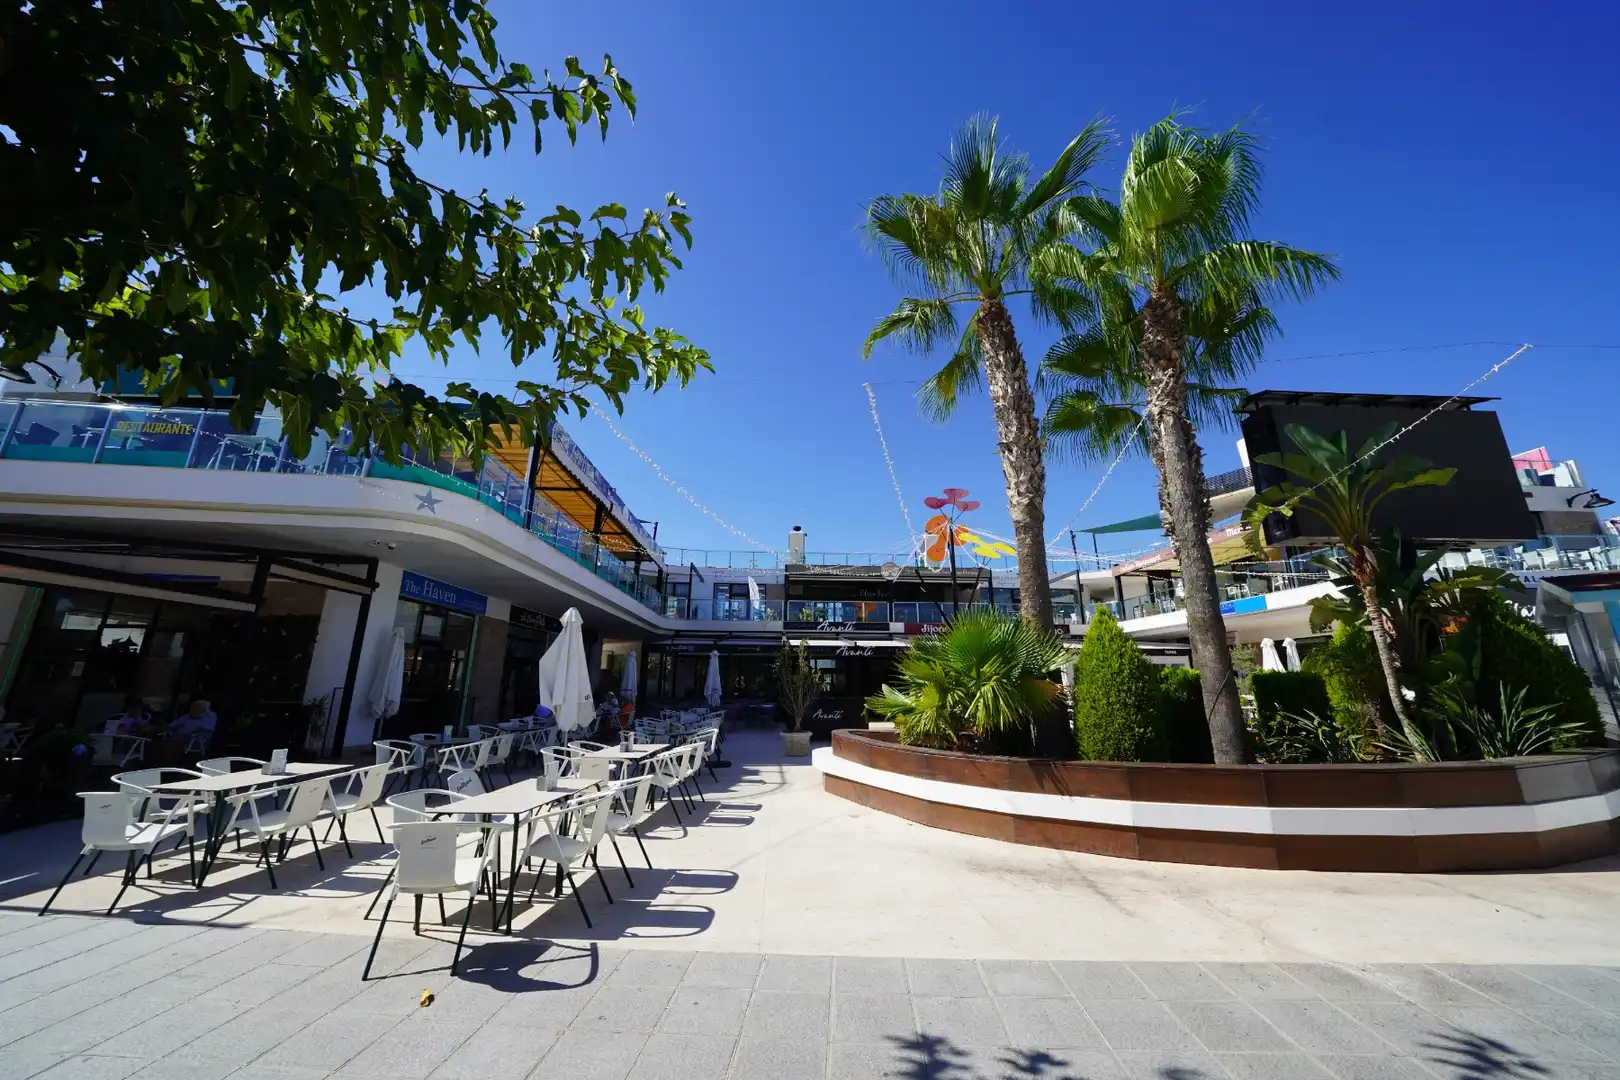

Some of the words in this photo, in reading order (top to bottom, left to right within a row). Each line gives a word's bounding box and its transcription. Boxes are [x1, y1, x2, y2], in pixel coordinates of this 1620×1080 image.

[116, 420, 194, 435] RESTAURANTE
[405, 579, 421, 594] The
[421, 580, 457, 604] Haven
[816, 620, 857, 632] Avanti
[835, 643, 876, 657] Avanti
[812, 708, 844, 720] Avanti
